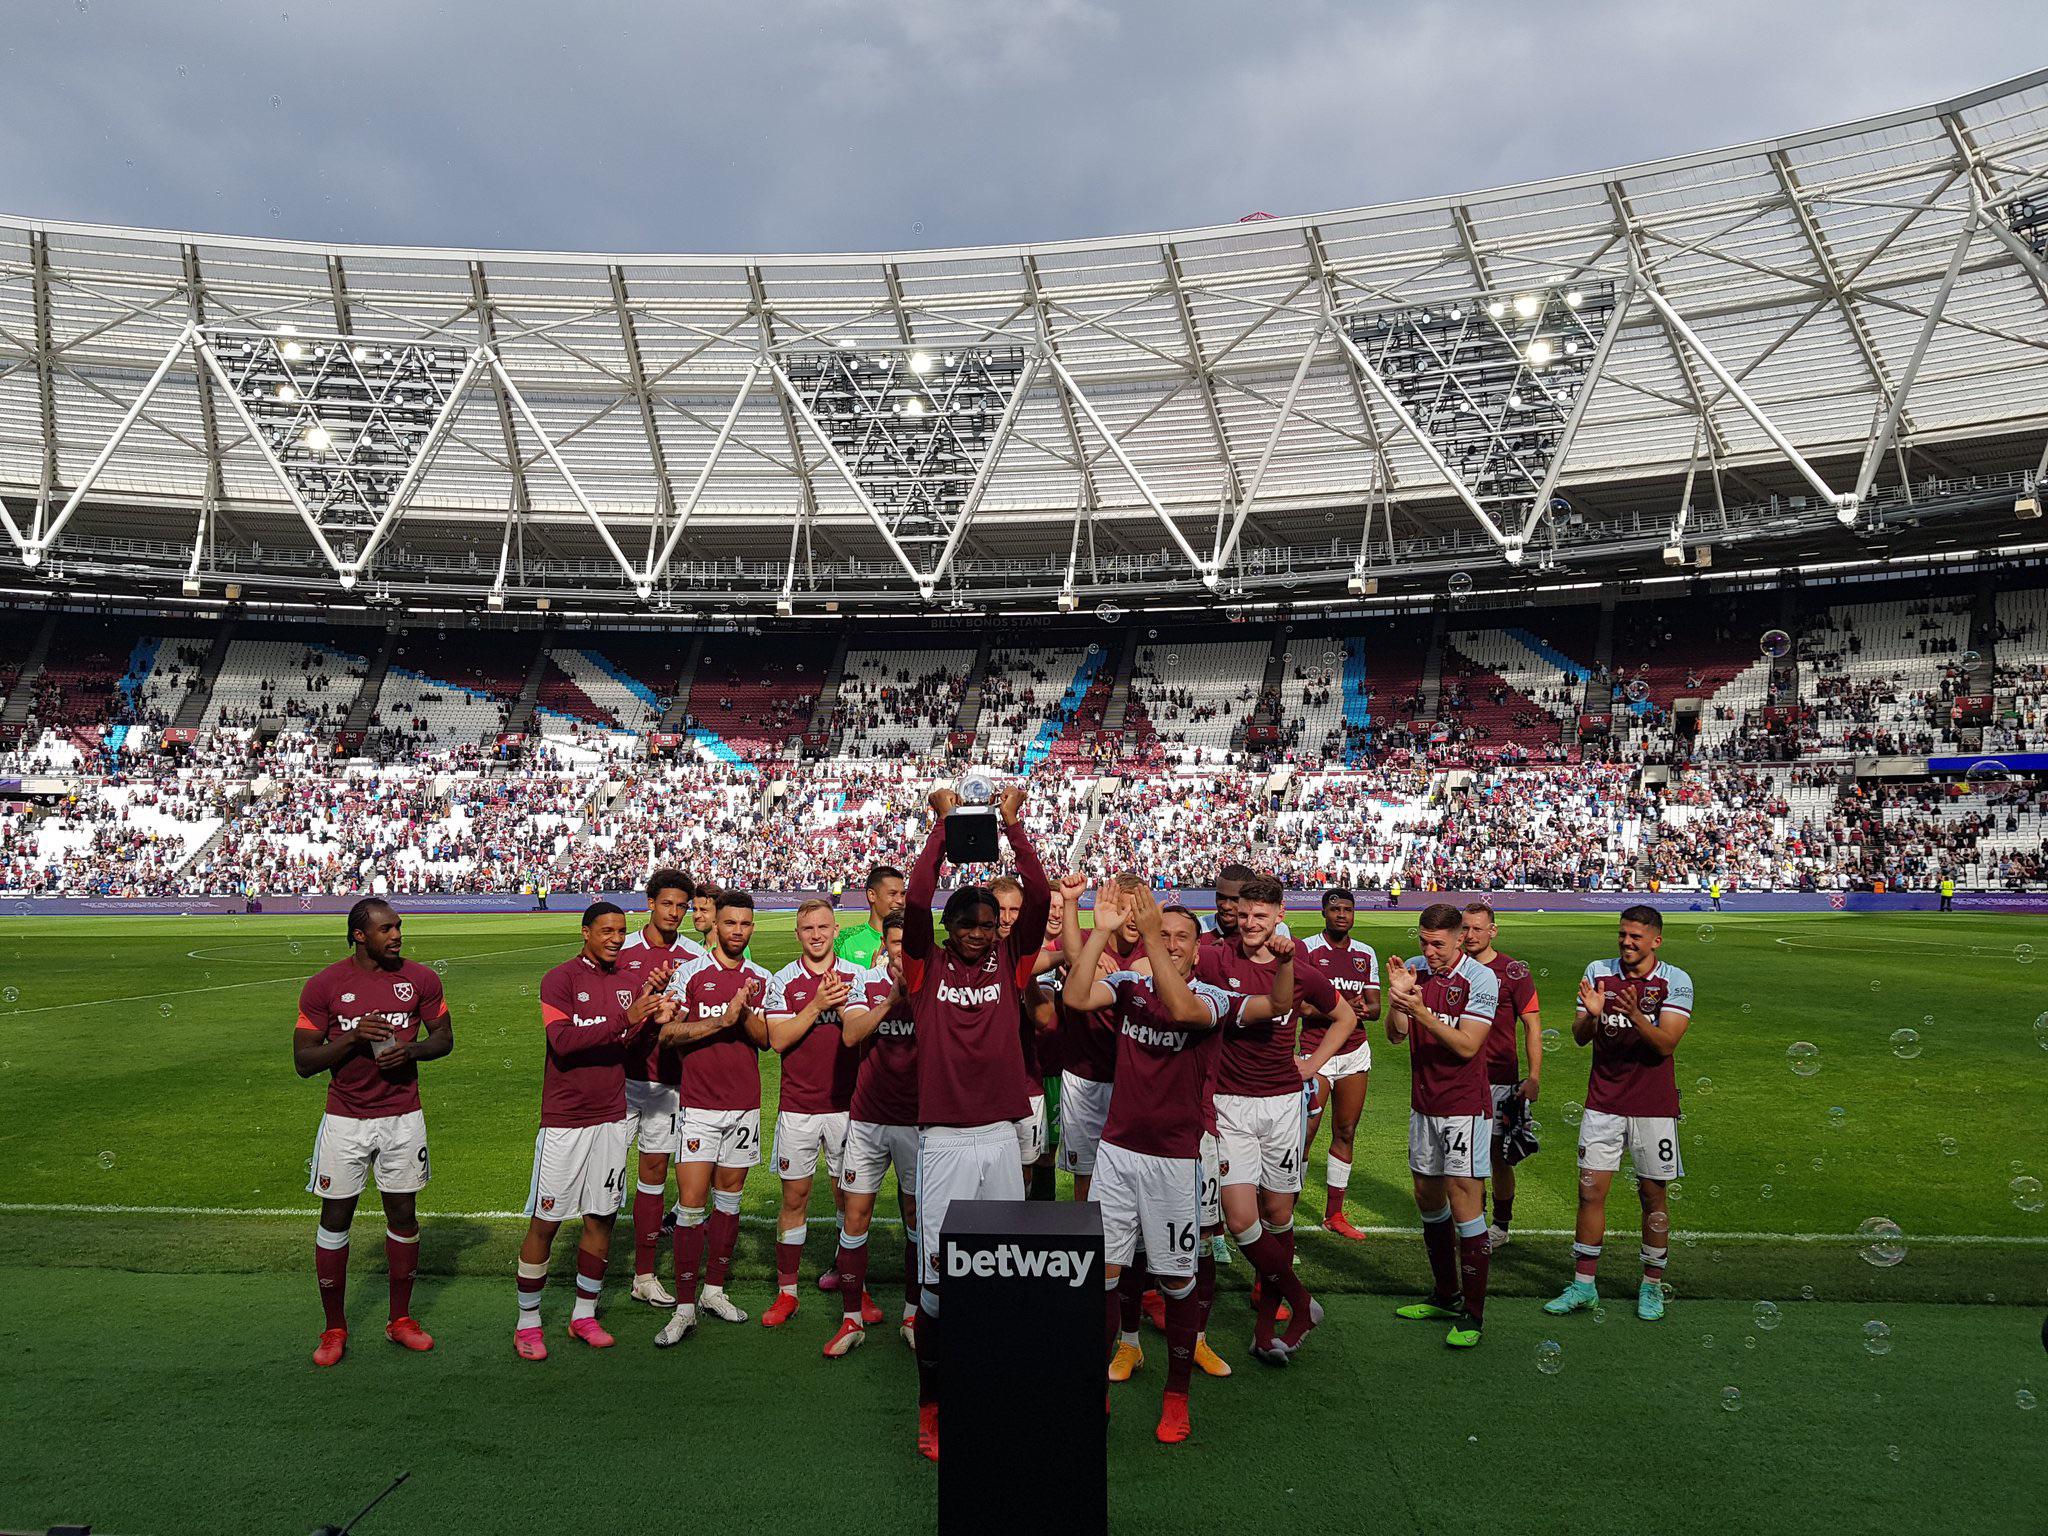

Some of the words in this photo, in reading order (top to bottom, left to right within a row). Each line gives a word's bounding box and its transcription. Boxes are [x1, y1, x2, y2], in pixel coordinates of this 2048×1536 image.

[931, 618, 962, 628] BILLY
[966, 617, 1008, 627] BONDS
[1012, 616, 1051, 626] STAND
[1121, 1015, 1189, 1052] betway
[735, 1123, 759, 1150] 24
[1658, 1138, 1674, 1162] 8
[418, 1146, 429, 1172] 9
[1279, 1147, 1299, 1174] 41
[604, 1166, 626, 1193] 40
[1167, 1222, 1196, 1252] 16
[947, 1241, 1096, 1287] betway
